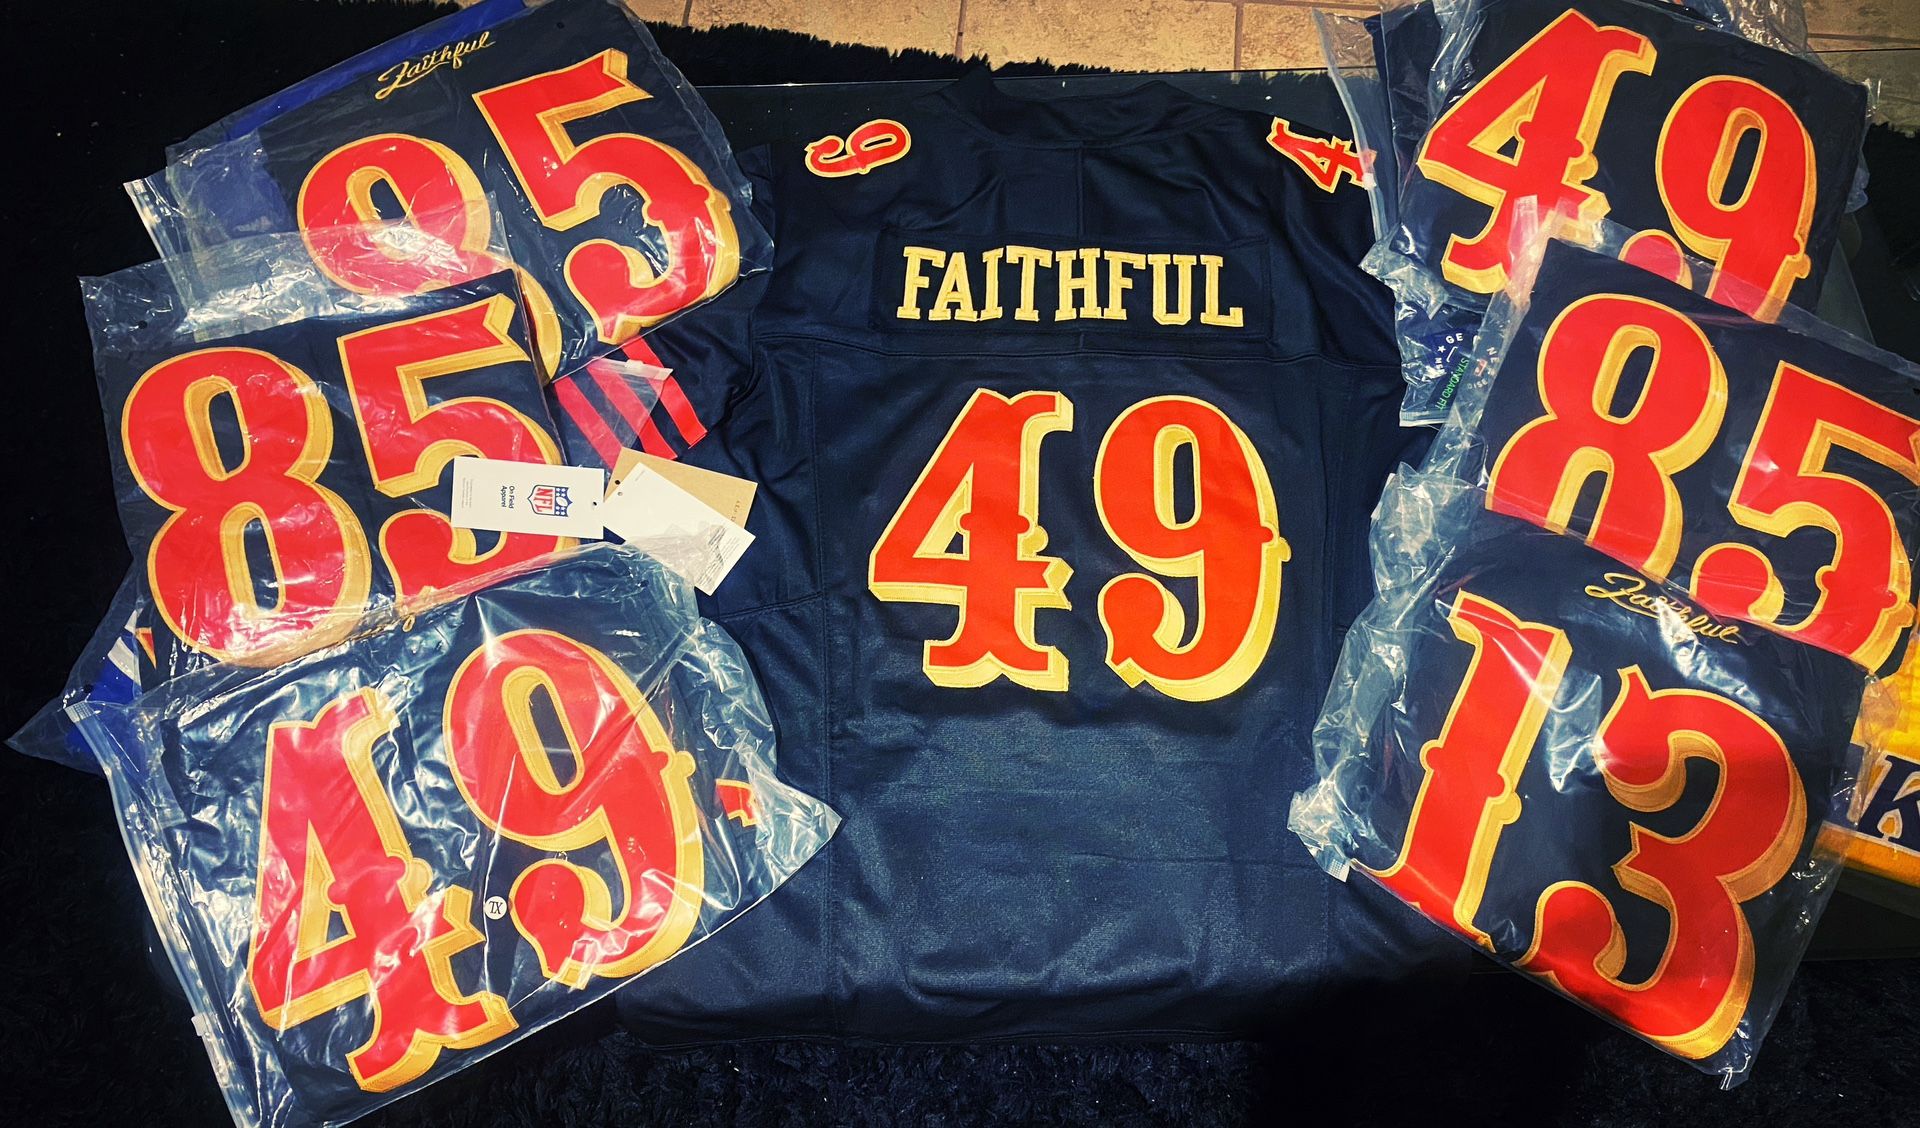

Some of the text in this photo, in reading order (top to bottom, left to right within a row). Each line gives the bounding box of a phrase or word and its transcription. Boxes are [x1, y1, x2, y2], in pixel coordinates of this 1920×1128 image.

[297, 47, 740, 384] 85
[375, 31, 496, 100] Faithful
[1267, 116, 1377, 194] 4
[1416, 8, 1817, 323] 49
[897, 245, 1244, 328] FAITHFUL
[121, 293, 579, 668] 85
[534, 487, 554, 513] NFL
[867, 387, 1291, 702] 49
[1485, 293, 1920, 675] 85
[248, 629, 703, 1093] 49
[1350, 588, 1807, 1060] 13
